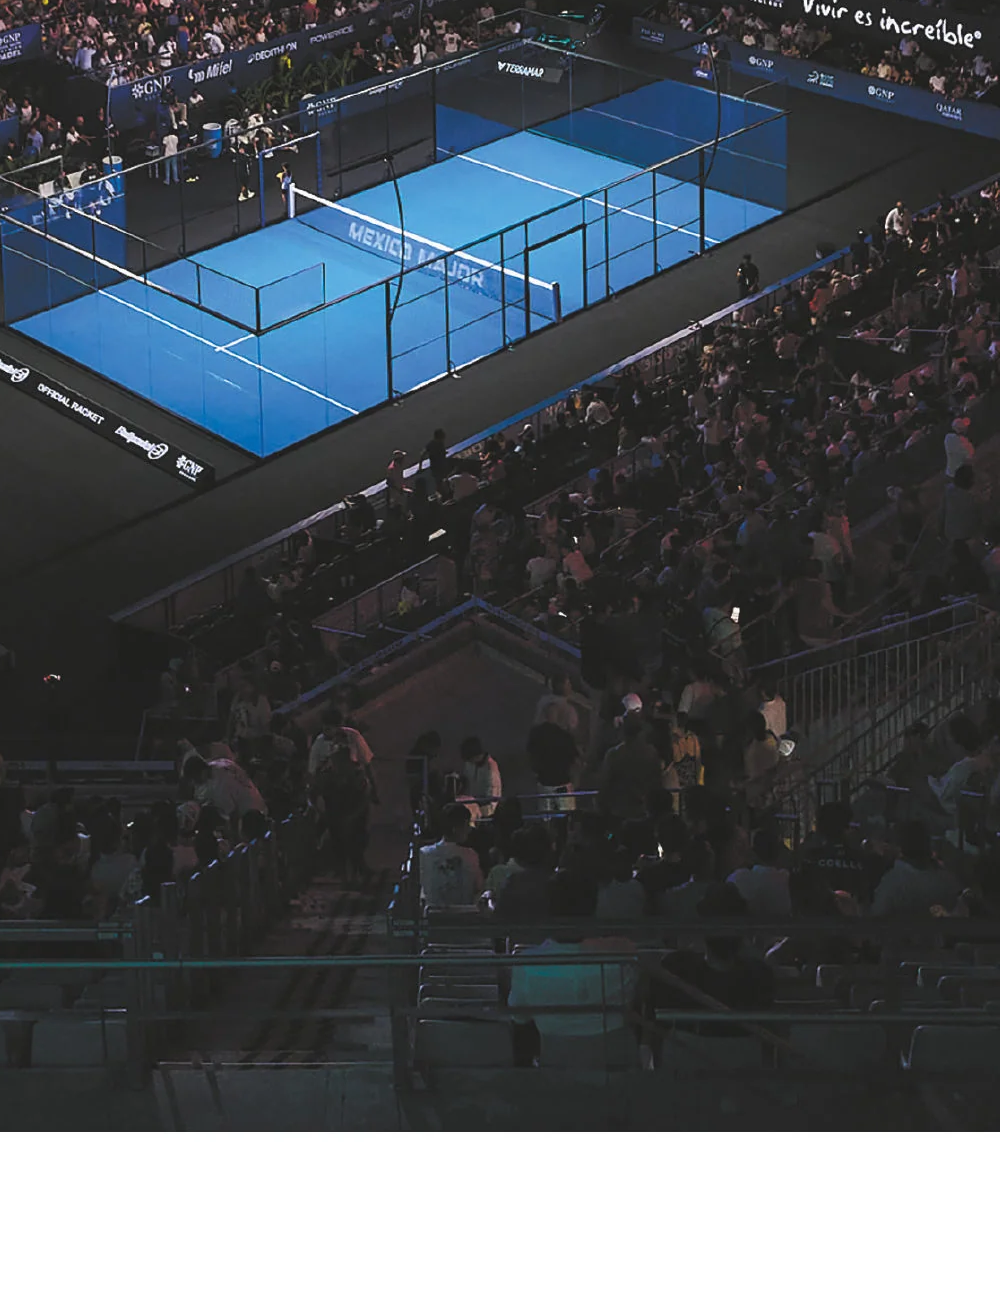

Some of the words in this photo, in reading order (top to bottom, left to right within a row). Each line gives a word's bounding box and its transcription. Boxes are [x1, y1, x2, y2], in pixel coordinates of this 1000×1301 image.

[853, 8, 873, 26] es
[2, 32, 21, 45] GNP
[206, 59, 233, 80] Mifel
[143, 75, 171, 95] GNP
[875, 88, 895, 100] GNP
[936, 102, 962, 116] QATAR
[348, 221, 413, 261] MEXICO
[417, 246, 485, 288] MAJOR
[36, 382, 70, 408] OFFICIAL
[70, 400, 105, 426] RACKET
